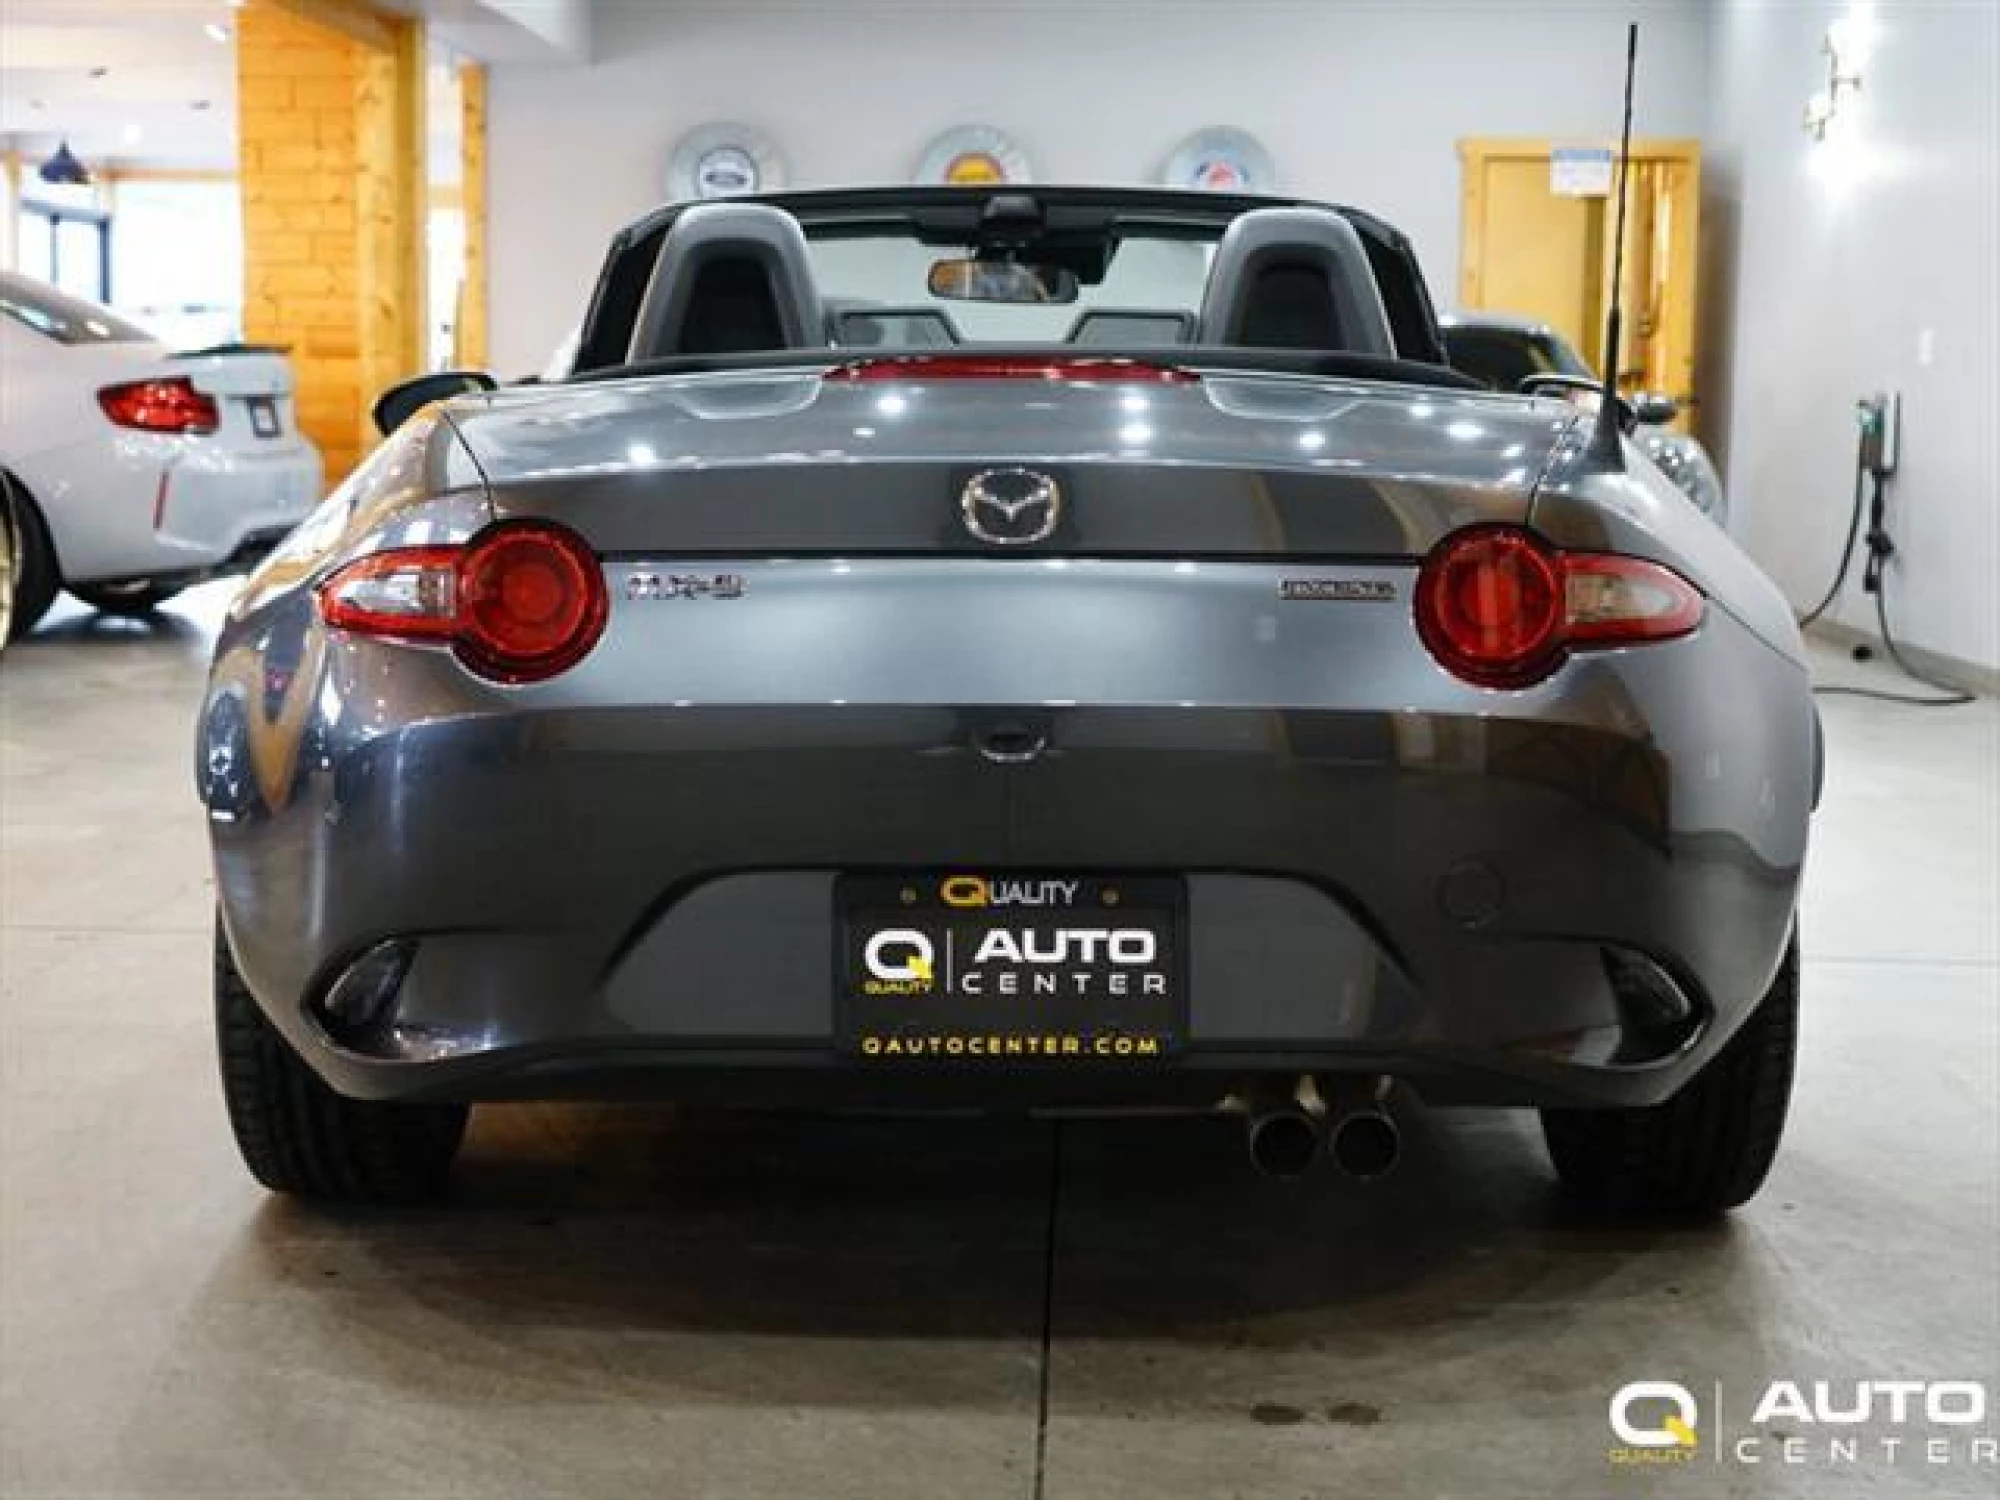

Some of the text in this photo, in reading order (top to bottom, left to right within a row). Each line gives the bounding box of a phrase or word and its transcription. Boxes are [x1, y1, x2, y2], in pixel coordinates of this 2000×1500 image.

[941, 876, 1078, 906] QUALITY
[974, 928, 1156, 964] AUTO
[961, 972, 1168, 995] CENTER
[862, 1035, 1159, 1055] QAUTOCENTER.COM
